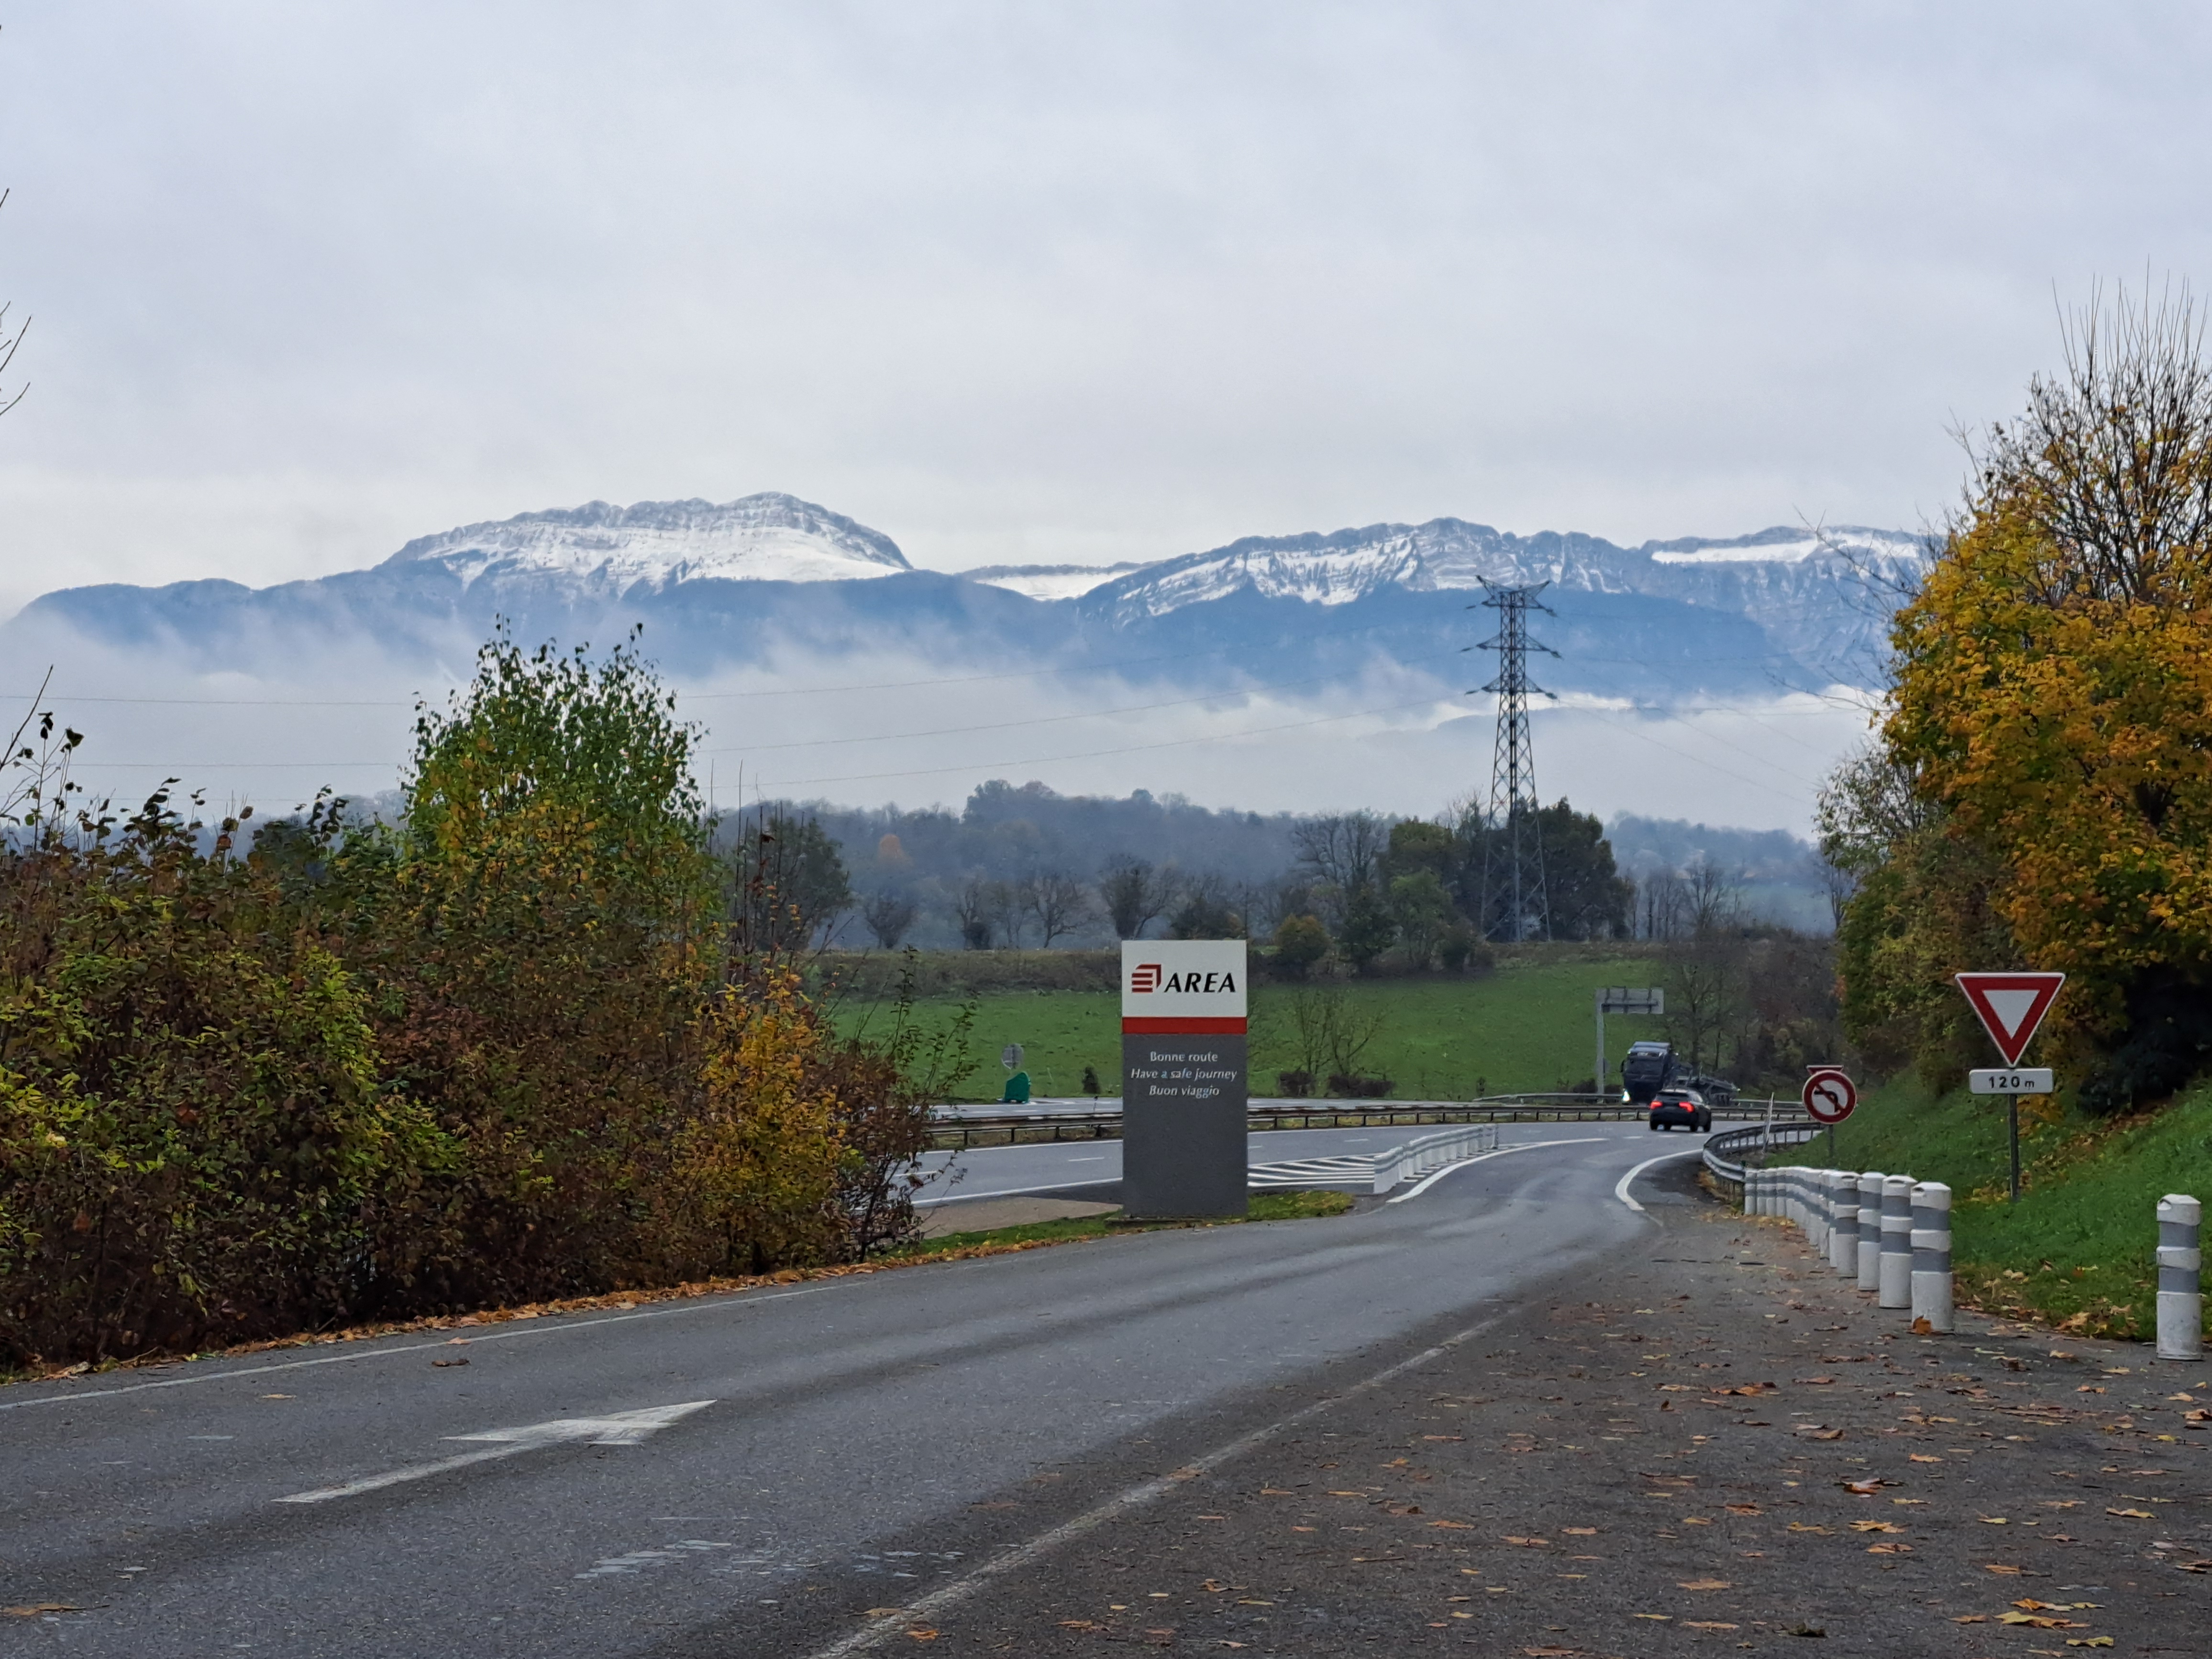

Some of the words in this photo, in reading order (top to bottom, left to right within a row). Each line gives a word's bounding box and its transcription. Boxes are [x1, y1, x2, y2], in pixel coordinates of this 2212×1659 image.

[1163, 972, 1236, 993] AREA
[1150, 1051, 1185, 1062] Bonne
[1188, 1051, 1218, 1062] route
[1131, 1068, 1158, 1079] Have
[1161, 1070, 1168, 1078] a
[1171, 1068, 1192, 1079] safe
[1194, 1068, 1238, 1082] journey
[1989, 1076, 2020, 1088] 120
[2024, 1080, 2035, 1089] m
[1149, 1085, 1177, 1096] Buon
[1182, 1085, 1220, 1099] viaggio
